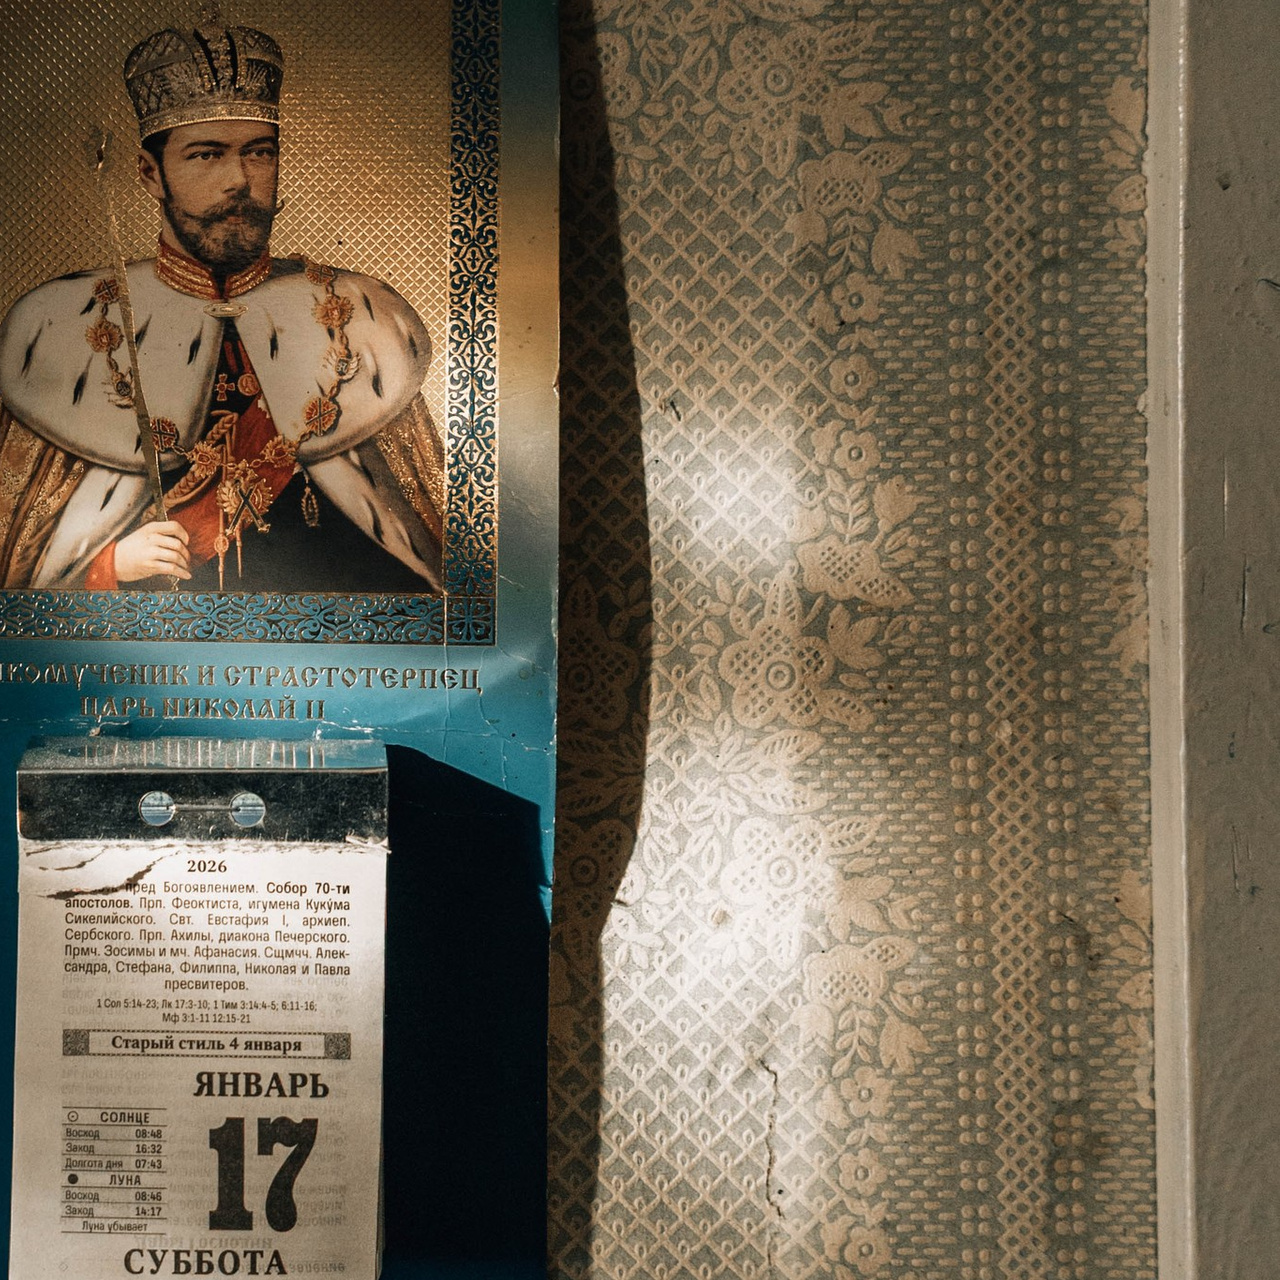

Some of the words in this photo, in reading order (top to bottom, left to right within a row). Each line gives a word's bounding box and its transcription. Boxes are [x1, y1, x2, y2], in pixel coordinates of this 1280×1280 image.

[197, 664, 215, 686] И
[223, 665, 483, 697] СТРАСТОТЕРПЕЦ
[79, 696, 155, 722] ЦАРЬ
[162, 694, 296, 720] НИКОЛАЙ
[187, 859, 228, 873] 2026
[125, 882, 156, 895] пред
[163, 881, 259, 894] Богоявлением.
[266, 881, 308, 896] Собор
[315, 882, 351, 895] 70-ти
[65, 898, 133, 909] апостолов.
[139, 897, 166, 912] Прп.
[171, 897, 242, 911] Феоктиста,
[248, 899, 300, 913] игумена
[65, 911, 156, 925] Сикелийского.
[169, 913, 194, 925] Свт.
[207, 913, 269, 929] Евстафия
[302, 916, 350, 931] архиеп.
[64, 928, 134, 943] Сербского.
[139, 929, 166, 943] Прп.
[170, 929, 214, 943] Ахилы,
[218, 931, 270, 944] диакона
[275, 930, 350, 945] Печерского.
[64, 944, 100, 959] Прмч.
[104, 945, 156, 957] Зосимы
[158, 948, 166, 957] и
[170, 948, 190, 958] мч.
[194, 945, 261, 960] Афанасия.
[264, 946, 312, 960] Сщмчч.
[315, 947, 350, 959] Алек-
[64, 962, 111, 976] сандра,
[115, 961, 175, 976] Стефана,
[179, 961, 240, 975] Филиппа,
[245, 962, 296, 975] Николая
[301, 965, 310, 975] и
[315, 963, 351, 976] Павла
[164, 979, 249, 993] пресвитеров.
[97, 998, 102, 1008] 1
[104, 998, 122, 1008] Сол
[123, 998, 159, 1010] 5:14-23;
[161, 999, 172, 1009] Лк
[175, 999, 211, 1011] 17:3-10;
[213, 1000, 218, 1009] 1
[221, 1000, 237, 1010] Тим
[240, 1000, 279, 1012] 3:14:4-5;
[281, 1001, 317, 1012] 6:11-16;
[162, 1013, 180, 1024] Мф
[182, 1013, 209, 1023] 3:1-11
[213, 1014, 251, 1024] 12:15-21
[111, 1035, 174, 1053] Старый
[178, 1039, 225, 1050] стиль
[229, 1037, 239, 1050] 4
[243, 1040, 302, 1055] января
[193, 1071, 330, 1098] ЯНВАРЬ
[100, 1111, 150, 1126] СОЛНЦЕ
[65, 1127, 100, 1140] Восход
[135, 1129, 162, 1139] 08:48
[65, 1142, 95, 1155] Заход
[135, 1144, 162, 1154] 16:32
[65, 1158, 103, 1169] Долгота
[105, 1160, 123, 1170] дня
[135, 1159, 162, 1169] 07:43
[109, 1174, 142, 1186] ЛУНА
[208, 1116, 319, 1233] 17
[65, 1190, 100, 1202] Восход
[134, 1191, 162, 1201] 08:46
[65, 1205, 94, 1218] Заход
[135, 1206, 162, 1216] 14:17
[82, 1220, 105, 1233] Луна
[107, 1221, 148, 1233] убывает
[124, 1248, 288, 1276] СУББОТА
